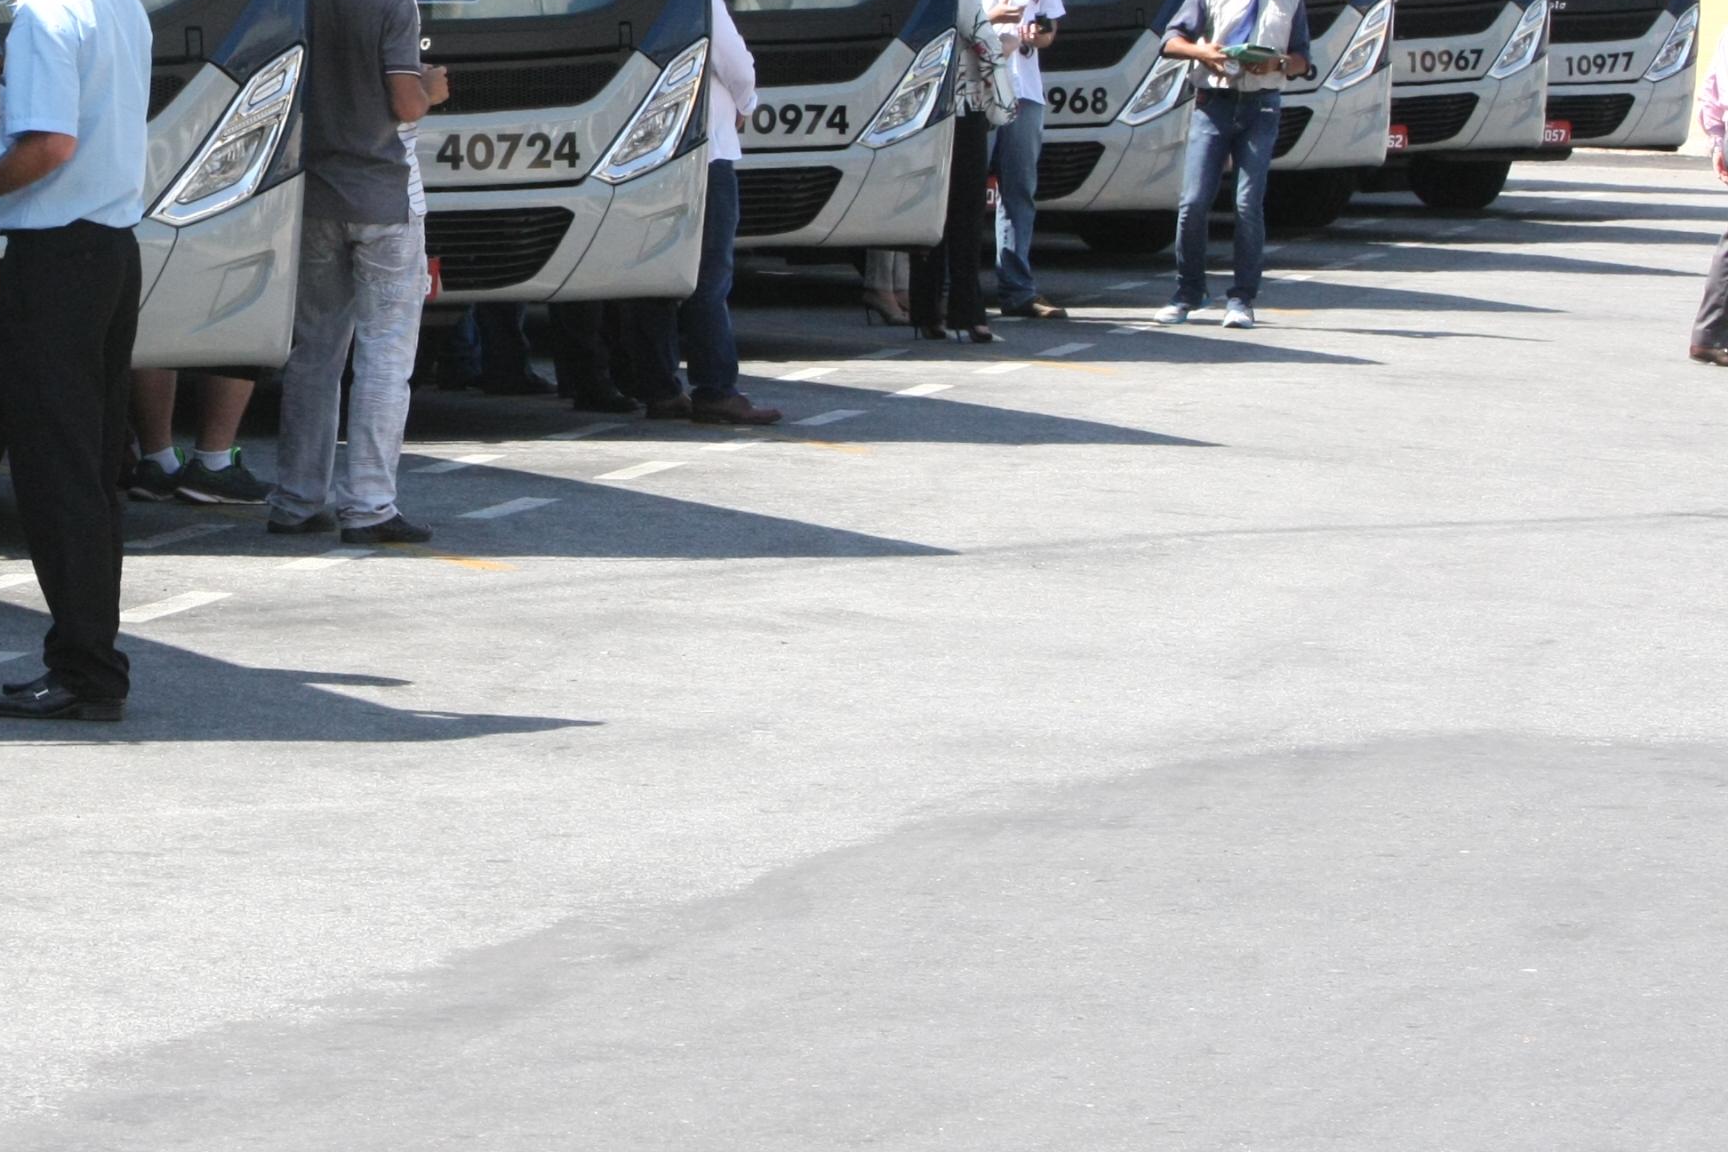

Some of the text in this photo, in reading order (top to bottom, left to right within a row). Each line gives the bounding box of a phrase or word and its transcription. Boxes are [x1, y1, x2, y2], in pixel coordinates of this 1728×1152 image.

[1407, 49, 1484, 73] 10967
[1566, 51, 1634, 77] 10977
[436, 131, 580, 171] 40724
